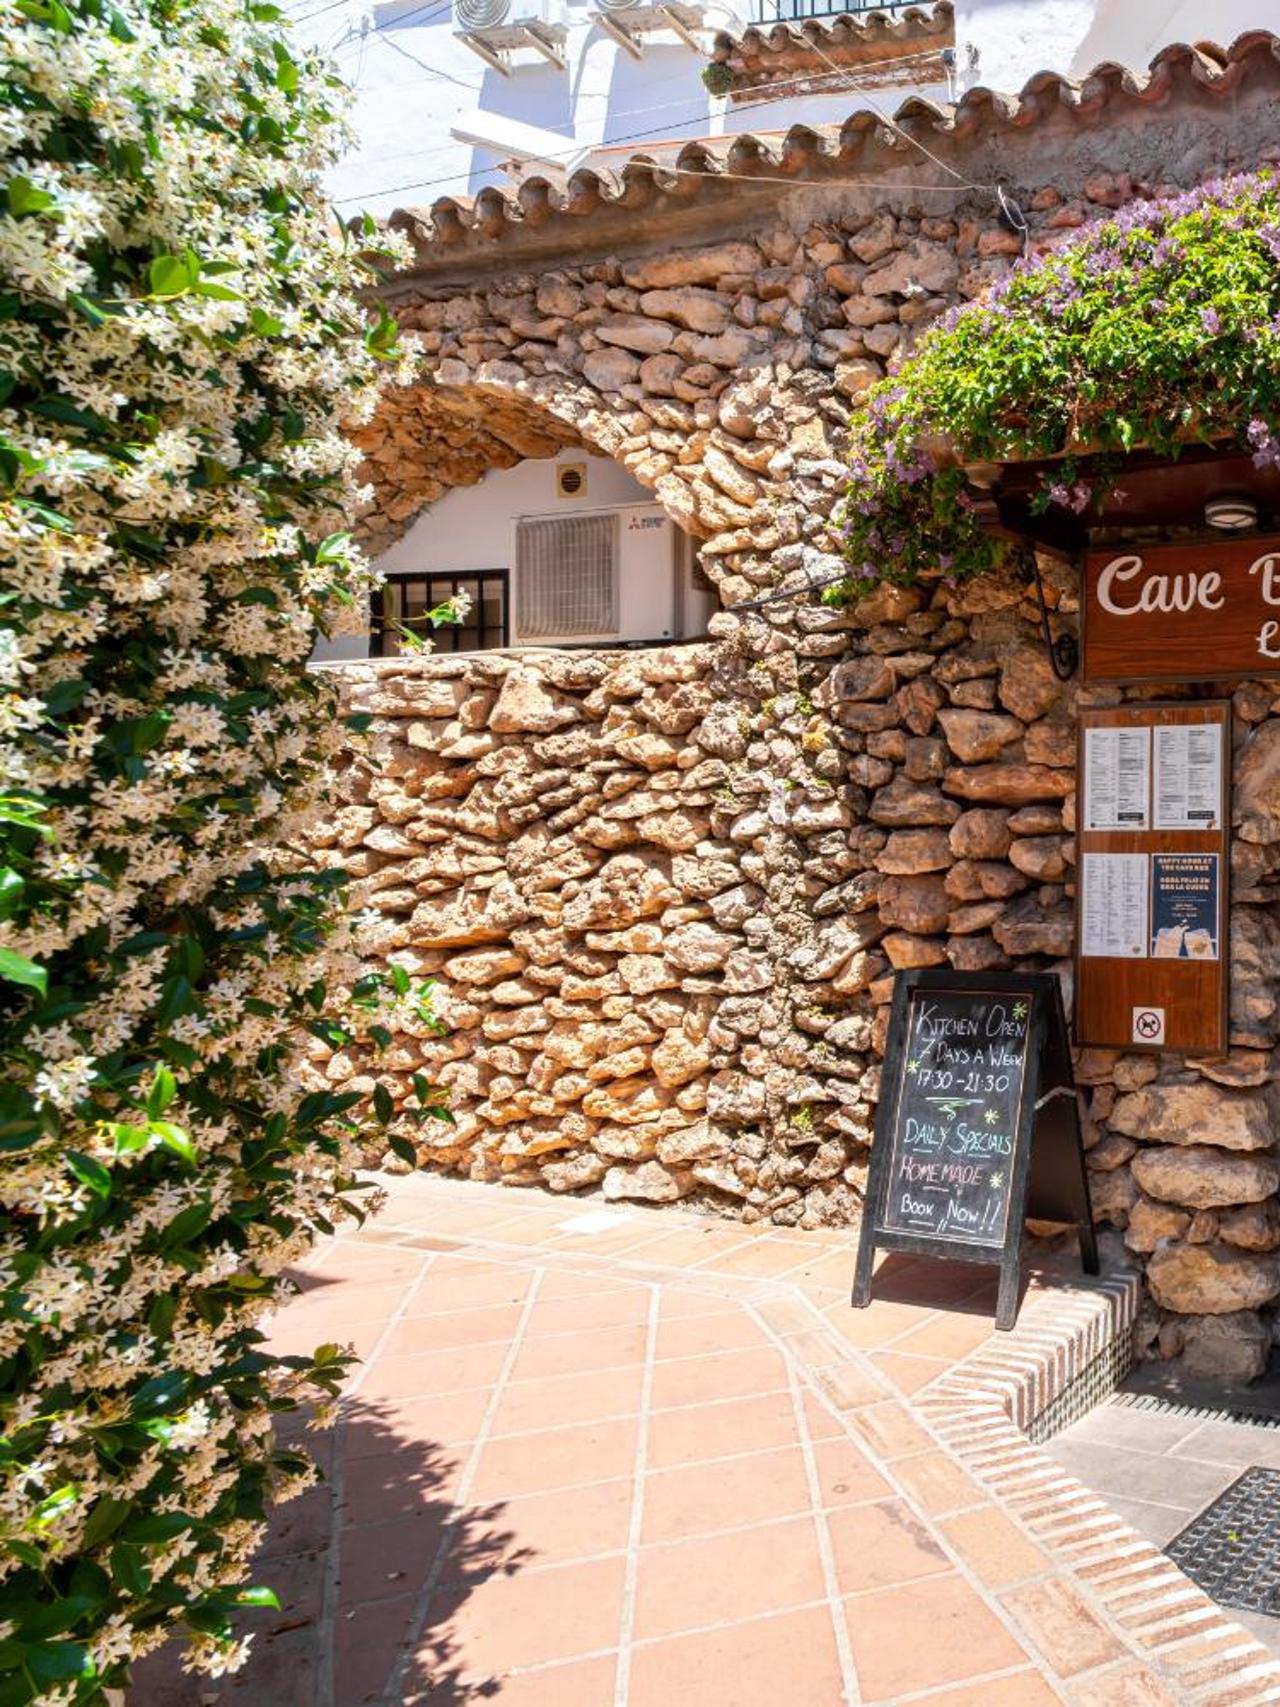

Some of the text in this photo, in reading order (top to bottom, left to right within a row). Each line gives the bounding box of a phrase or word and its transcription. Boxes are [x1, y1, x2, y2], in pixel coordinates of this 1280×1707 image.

[1096, 555, 1225, 616] Cave
[986, 1004, 1026, 1037] OPEN
[920, 1037, 1023, 1067] 7 DAYS A WEEK
[904, 1117, 1013, 1155] DAILY SPECIALS
